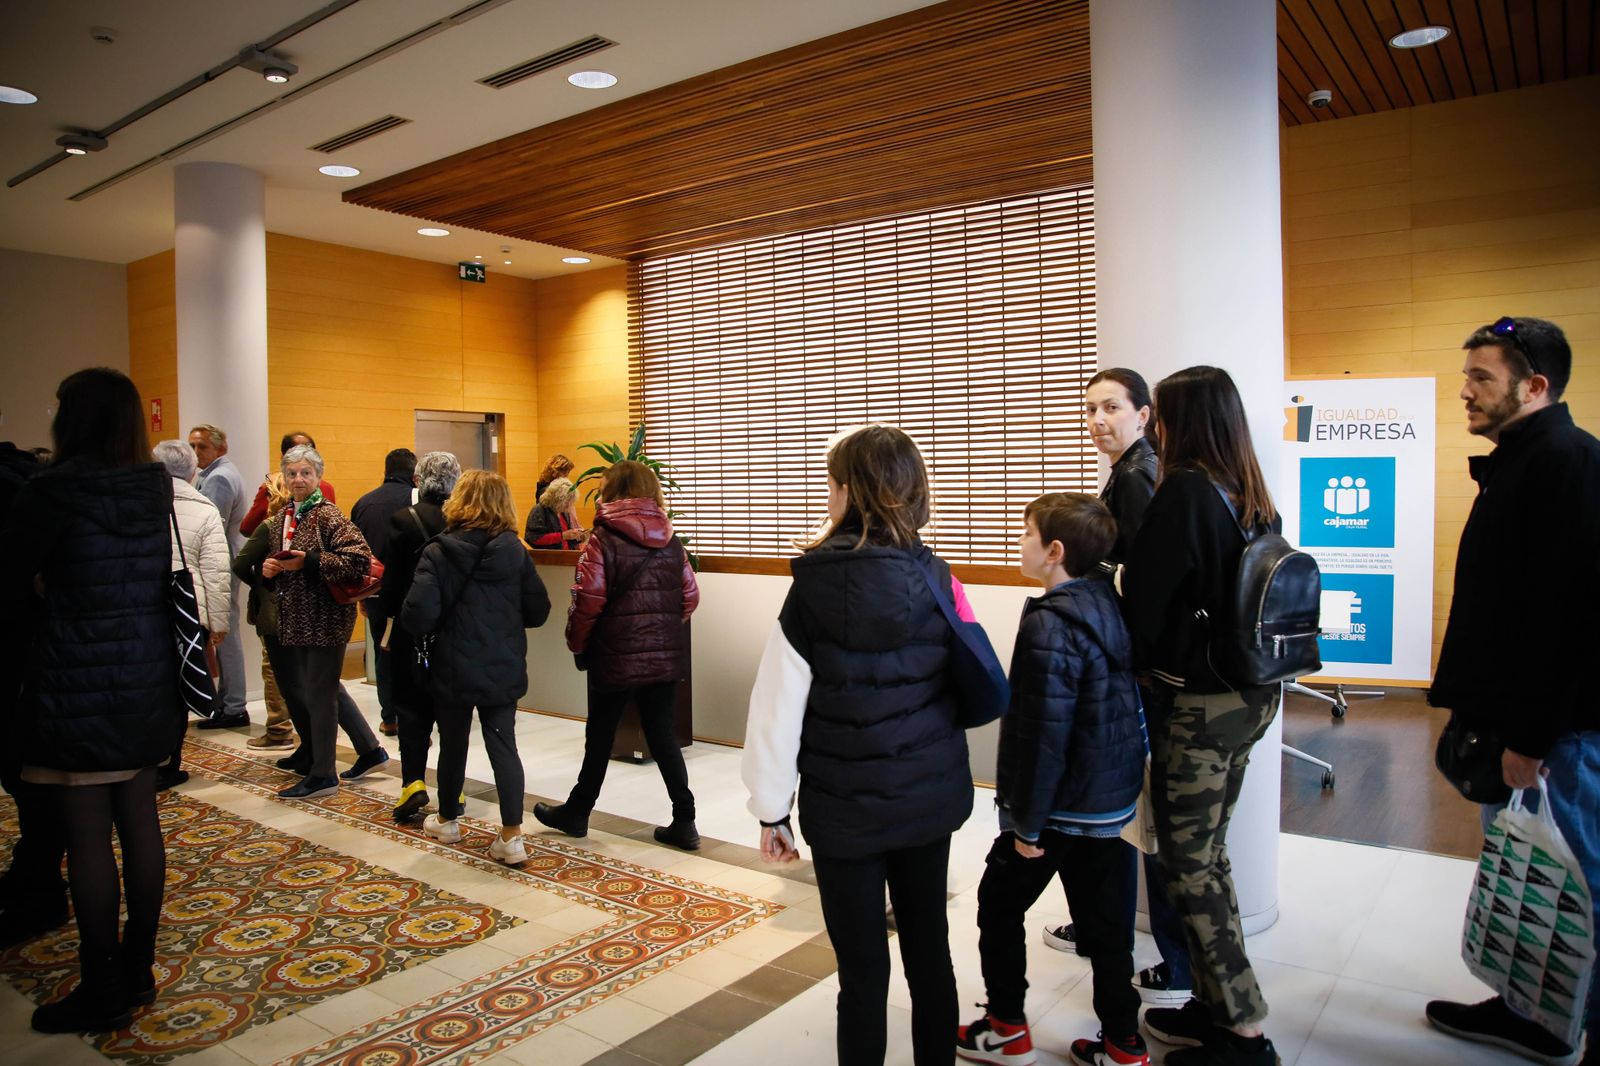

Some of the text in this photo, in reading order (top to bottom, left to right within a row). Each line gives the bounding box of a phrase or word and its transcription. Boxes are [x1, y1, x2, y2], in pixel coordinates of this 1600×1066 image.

[1318, 408, 1398, 421] IGUALDAD
[1316, 423, 1416, 440] EMPRESA
[1323, 516, 1370, 528] cajamar
